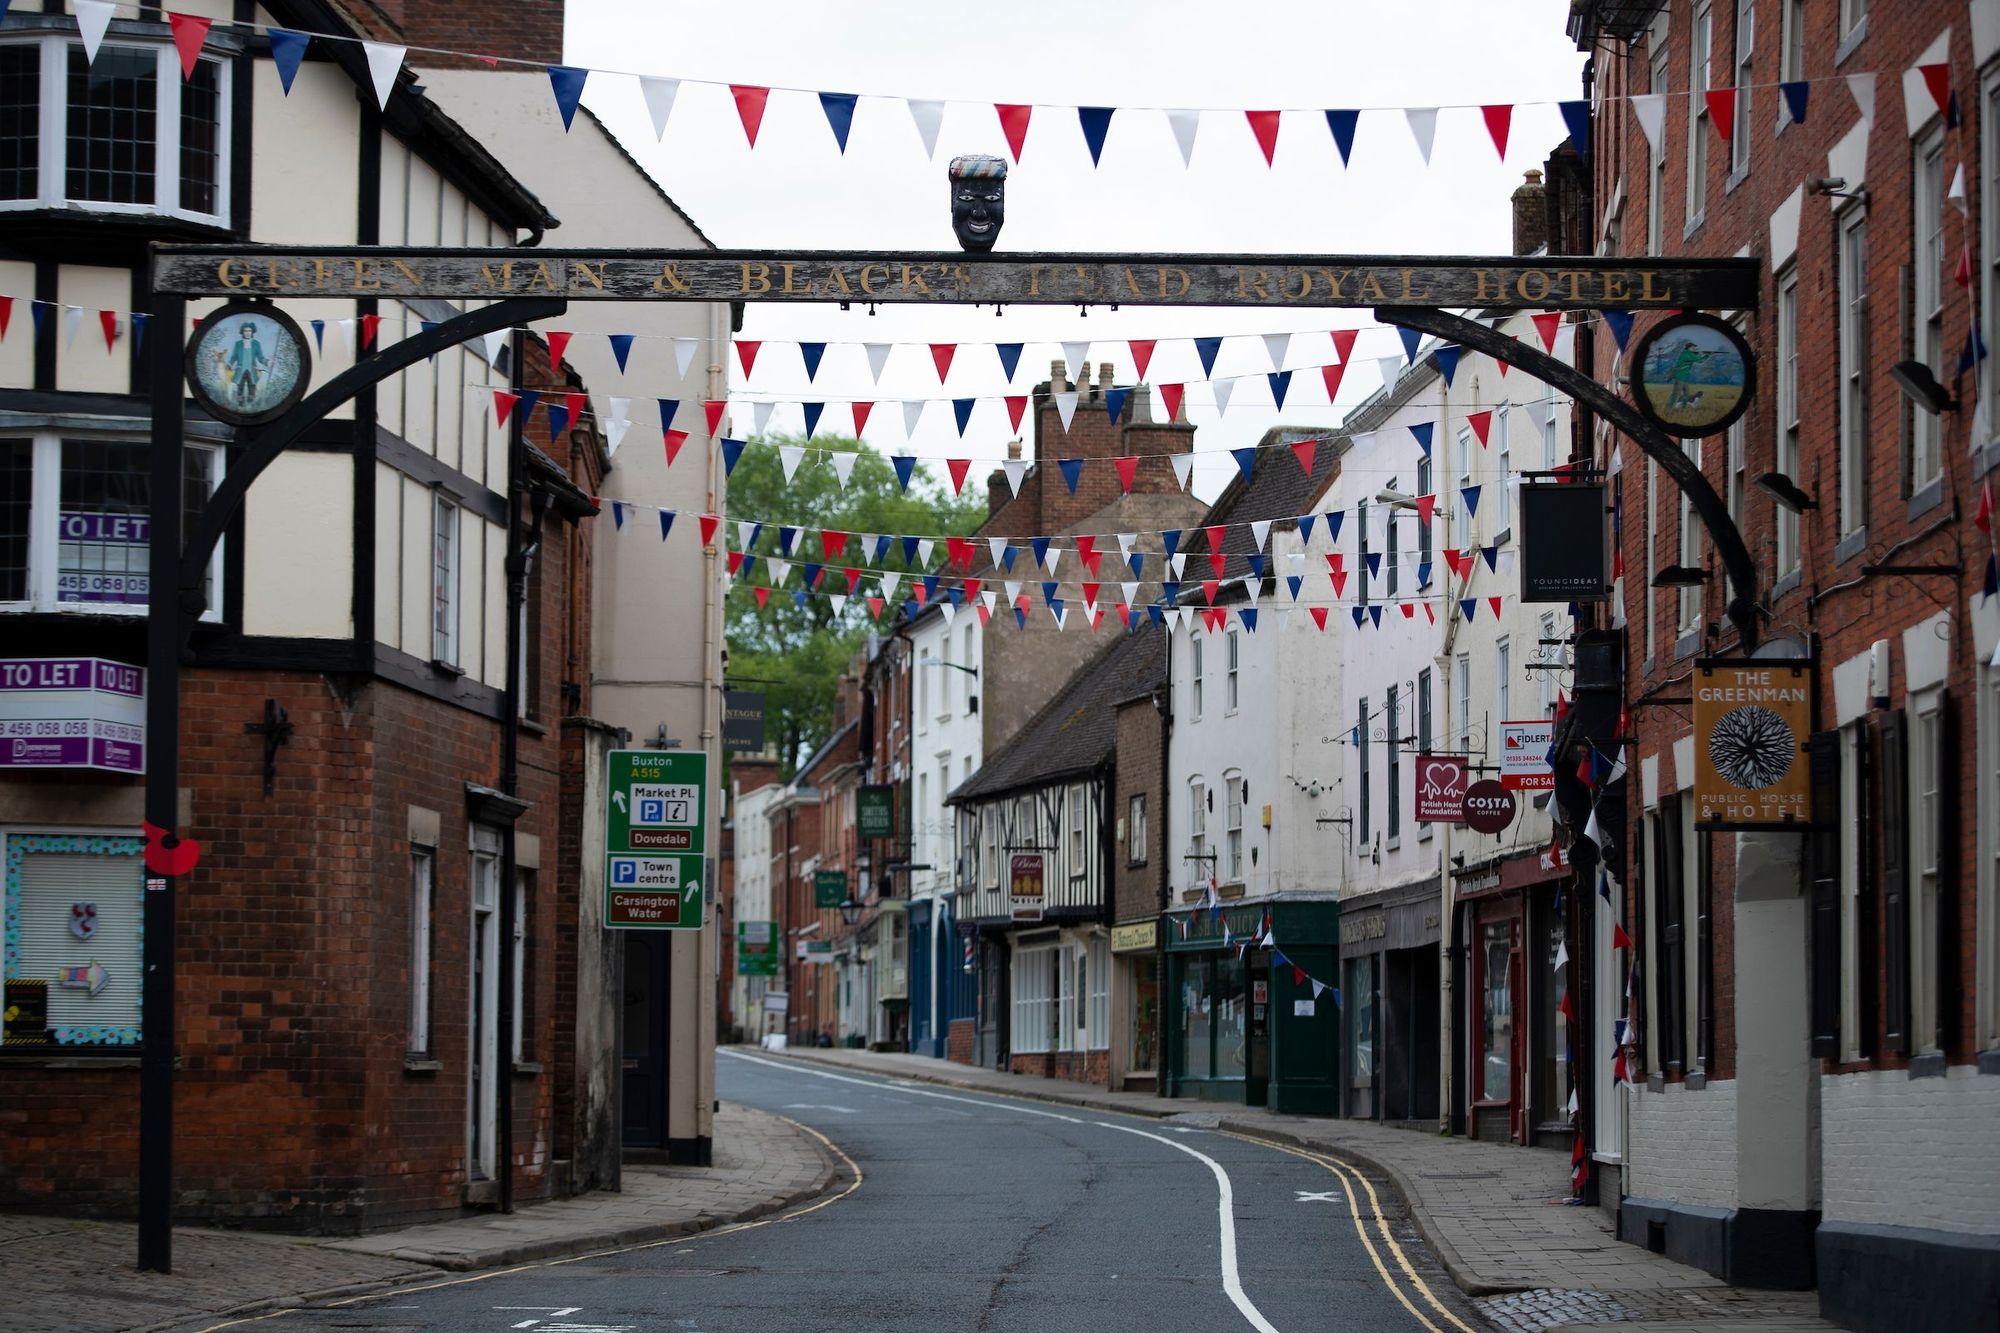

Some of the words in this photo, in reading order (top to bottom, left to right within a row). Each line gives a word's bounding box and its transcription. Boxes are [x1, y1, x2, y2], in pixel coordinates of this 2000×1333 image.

[217, 257, 424, 290] GREEN
[471, 260, 608, 291] MAN
[652, 262, 693, 293] &
[739, 262, 972, 295] BLACK'S
[1236, 267, 1431, 300] ROYAL
[1475, 270, 1672, 302] HOTEL
[96, 517, 147, 539] LET
[127, 579, 148, 591] 05
[3, 664, 32, 686] TO
[39, 663, 80, 686] LET
[101, 665, 115, 688] TO
[118, 669, 138, 692] LET
[1734, 672, 1770, 685] THE
[1699, 688, 1806, 702] GREENMAN
[726, 709, 762, 718] NTAGUE
[8, 722, 32, 735] 456
[36, 722, 60, 735] 058
[64, 722, 88, 735] 058
[632, 756, 672, 766] Buxton
[631, 768, 661, 778] A515
[1520, 777, 1539, 786] FOR
[1540, 777, 1555, 786] SAL
[635, 788, 676, 798] Market
[680, 788, 695, 799] Pl.
[1701, 795, 1747, 803] PUBLIC
[1760, 795, 1805, 803] HOUSE
[1421, 800, 1442, 808] British
[1467, 797, 1510, 809] COSTA
[1420, 808, 1462, 816] Foundation
[1702, 806, 1713, 818] &
[1727, 805, 1806, 817] HOTEL
[634, 834, 687, 844] Dovedale
[643, 862, 672, 871] Town
[1012, 857, 1041, 869] Birds
[619, 864, 633, 881] P
[639, 874, 676, 884] centre
[614, 895, 676, 909] Carsington
[628, 908, 662, 918] Water
[1215, 914, 1255, 934] COICE
